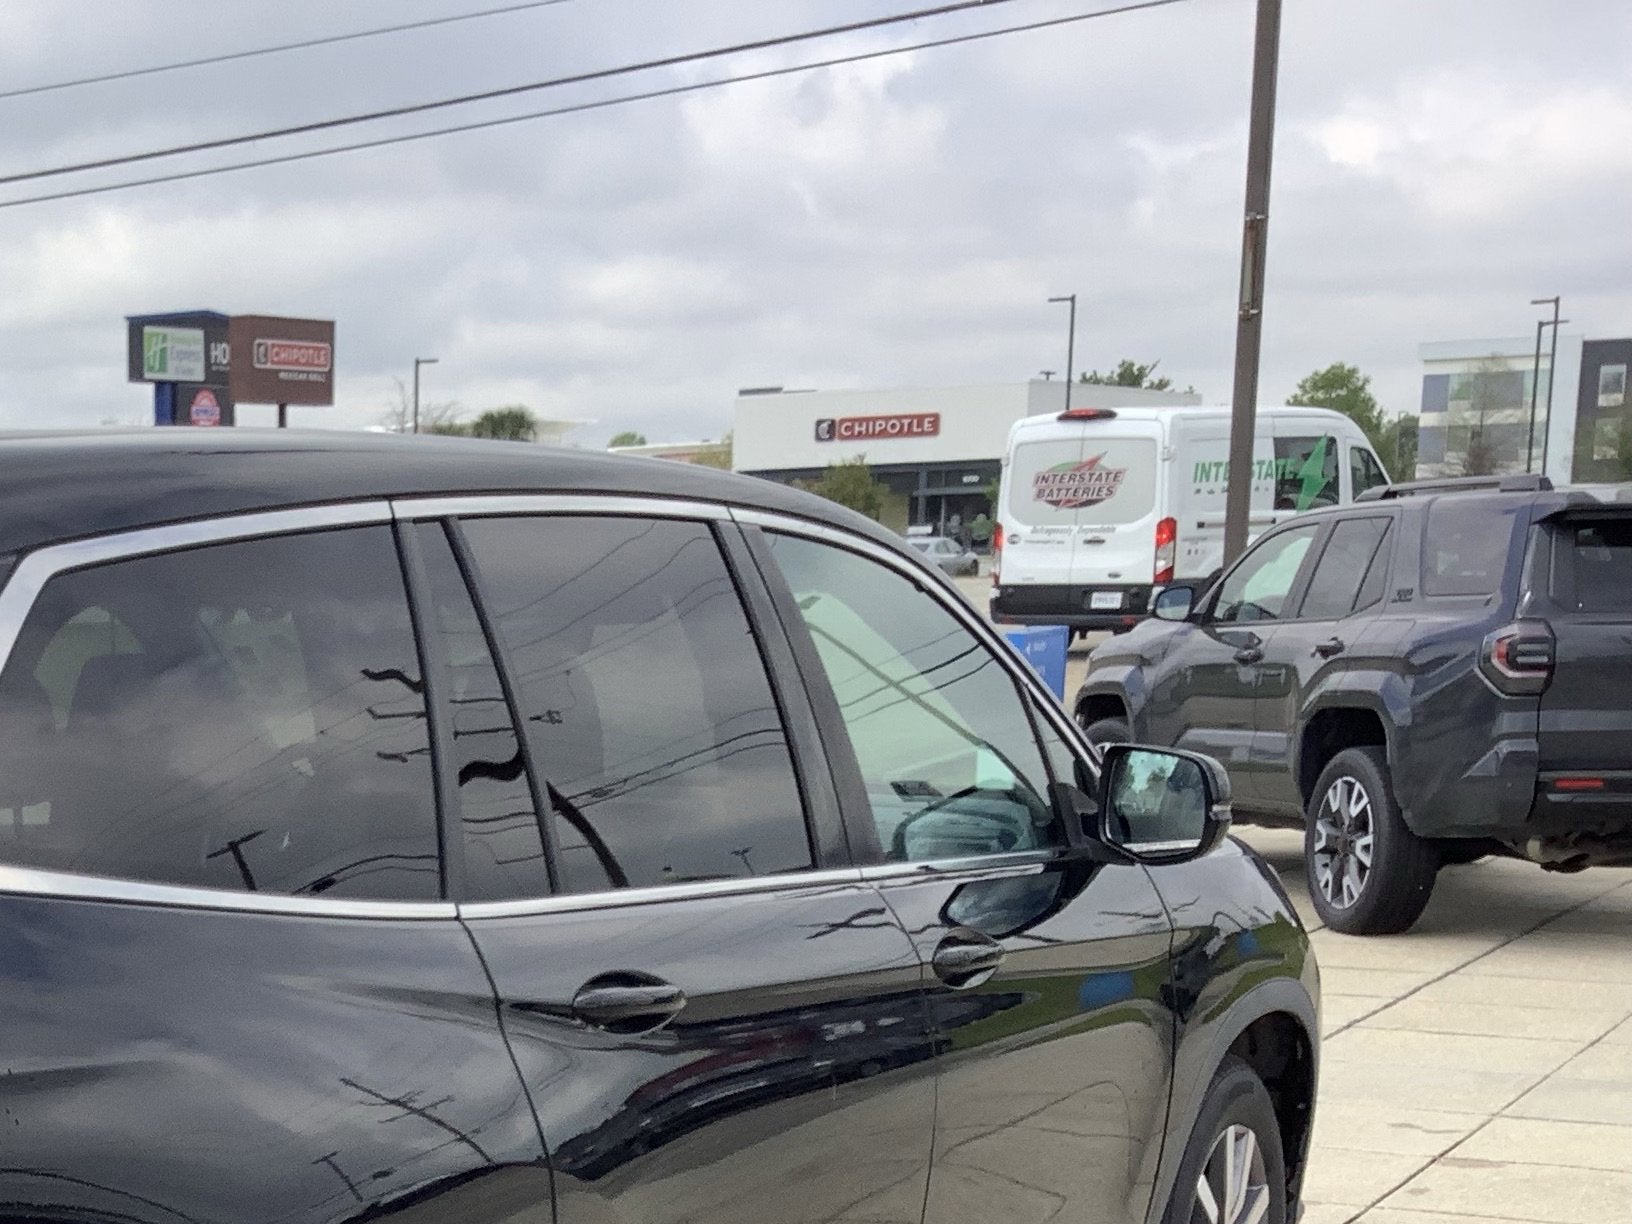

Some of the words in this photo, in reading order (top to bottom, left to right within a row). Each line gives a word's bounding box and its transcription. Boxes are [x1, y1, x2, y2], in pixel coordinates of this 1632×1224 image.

[272, 345, 327, 366] CHIPOTLE
[840, 416, 935, 437] CHIPOTLE
[1034, 470, 1123, 485] INTERSTATE
[1035, 485, 1114, 499] BATTERIES
